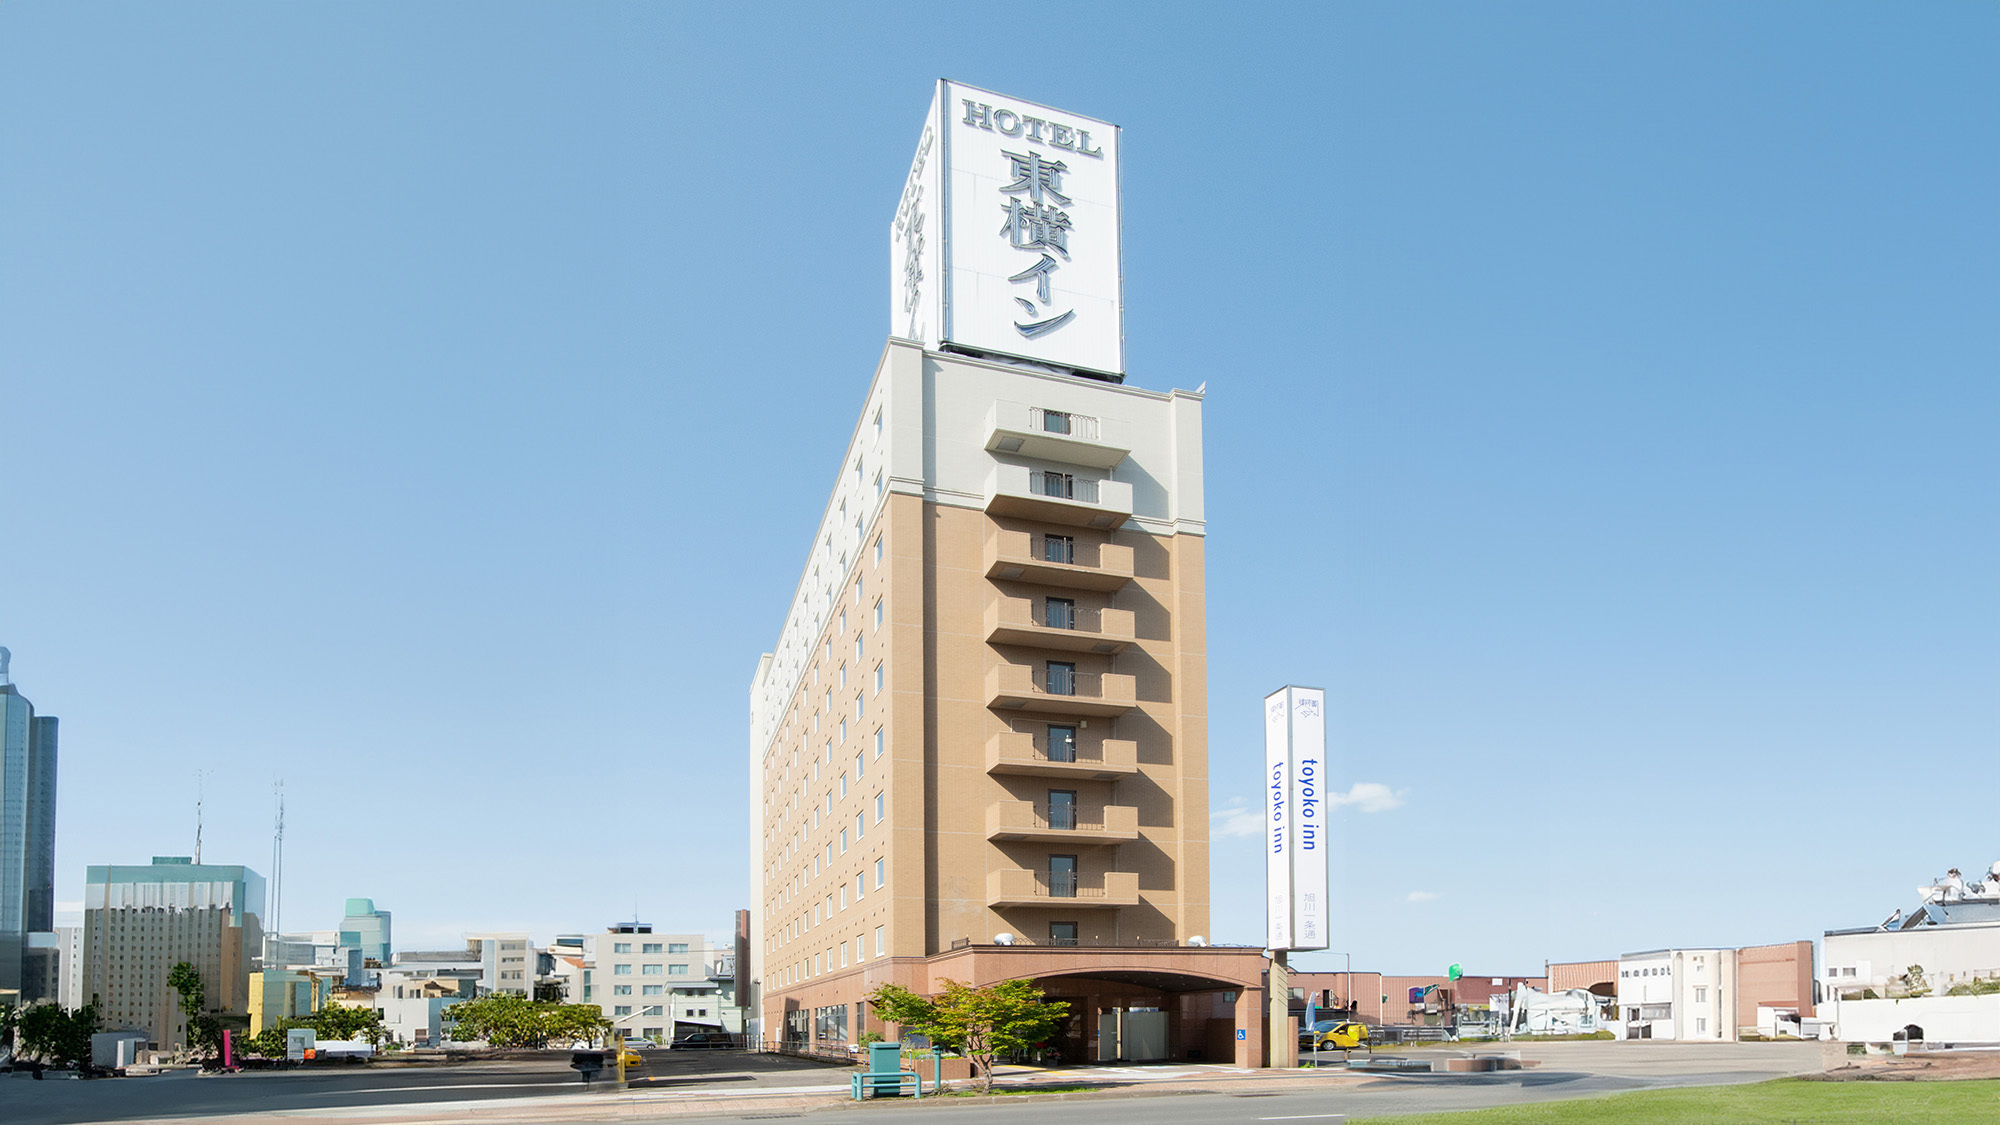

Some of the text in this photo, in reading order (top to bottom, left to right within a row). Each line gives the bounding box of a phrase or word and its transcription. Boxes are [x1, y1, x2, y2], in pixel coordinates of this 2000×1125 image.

[961, 98, 1104, 160] HOTEL
[999, 148, 1074, 338] 東横イン
[1271, 761, 1285, 854] toyoko inn
[1298, 759, 1319, 850] toyoko inn
[1303, 892, 1317, 940] 旭川一条通
